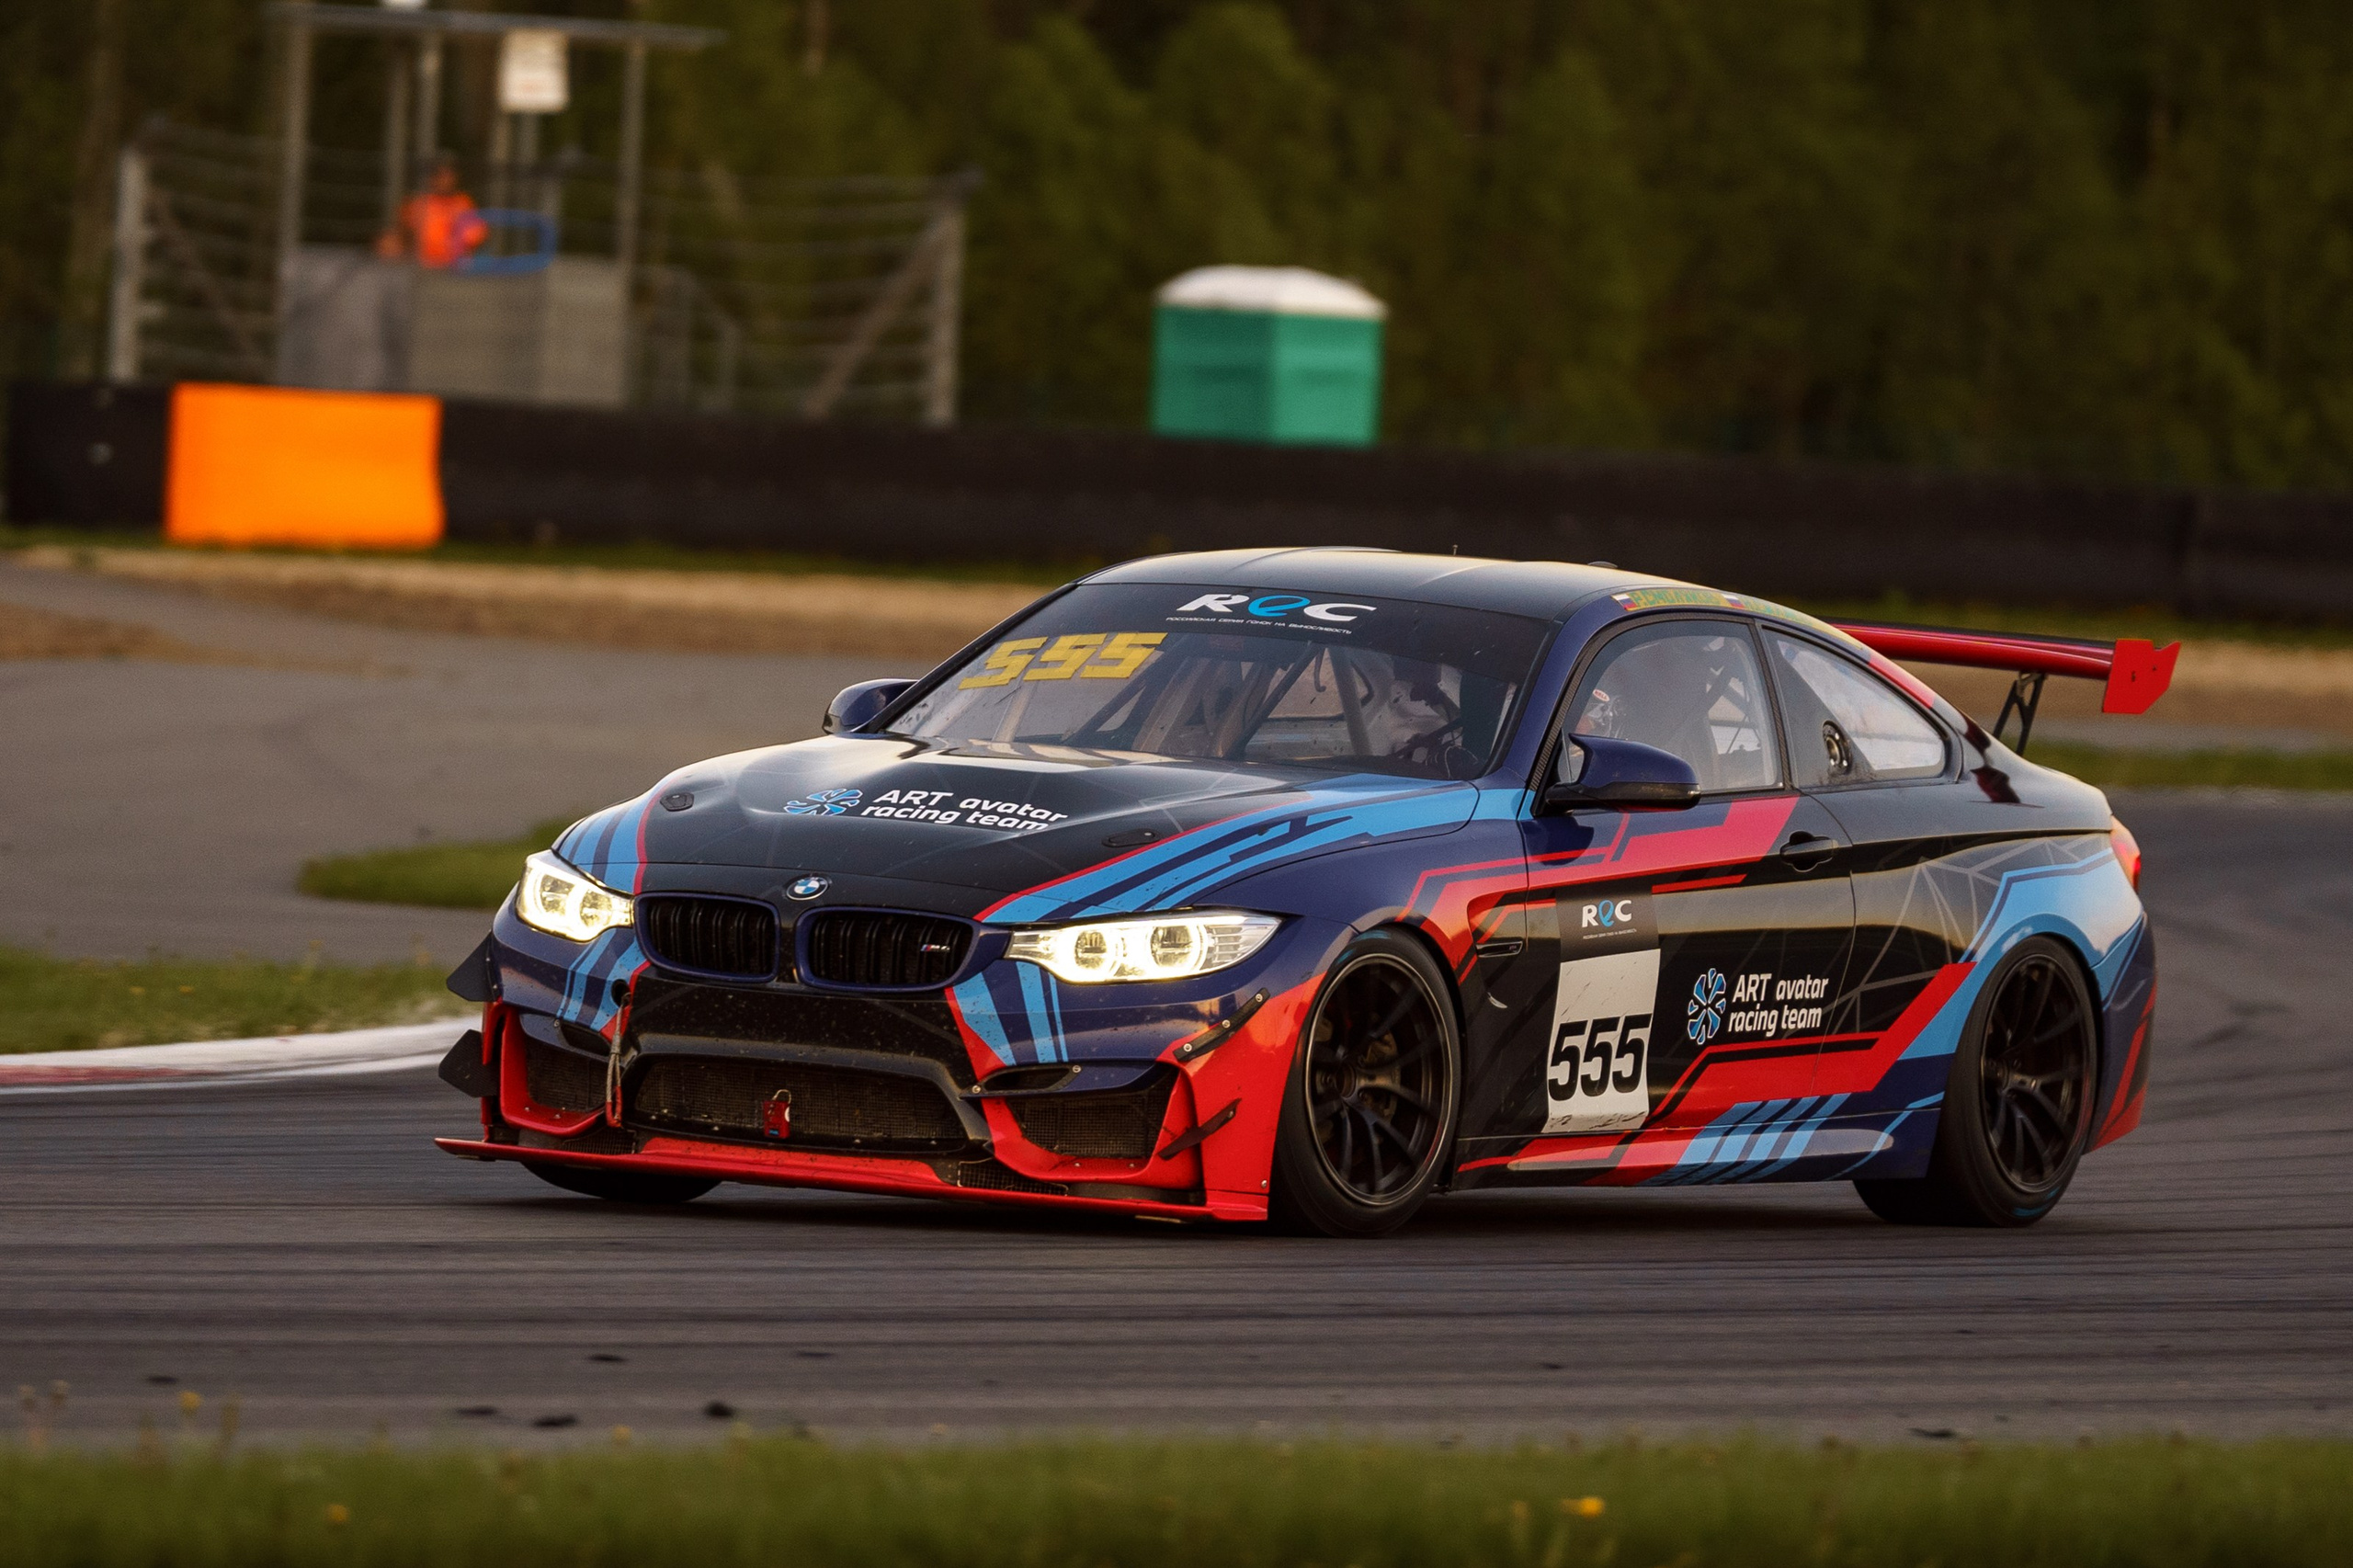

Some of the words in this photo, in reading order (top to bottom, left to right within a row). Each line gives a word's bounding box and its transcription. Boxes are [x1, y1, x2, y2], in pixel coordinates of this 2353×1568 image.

[959, 632, 1168, 690] 555
[860, 804, 961, 824] racing
[966, 811, 1050, 831] team
[872, 790, 954, 806] ART
[959, 797, 1069, 823] avatar
[1732, 972, 1772, 1003] ART
[1776, 974, 1829, 1001] avatar
[1728, 1004, 1778, 1037] racing
[1780, 1006, 1823, 1029] team
[1548, 1013, 1654, 1102] 555
